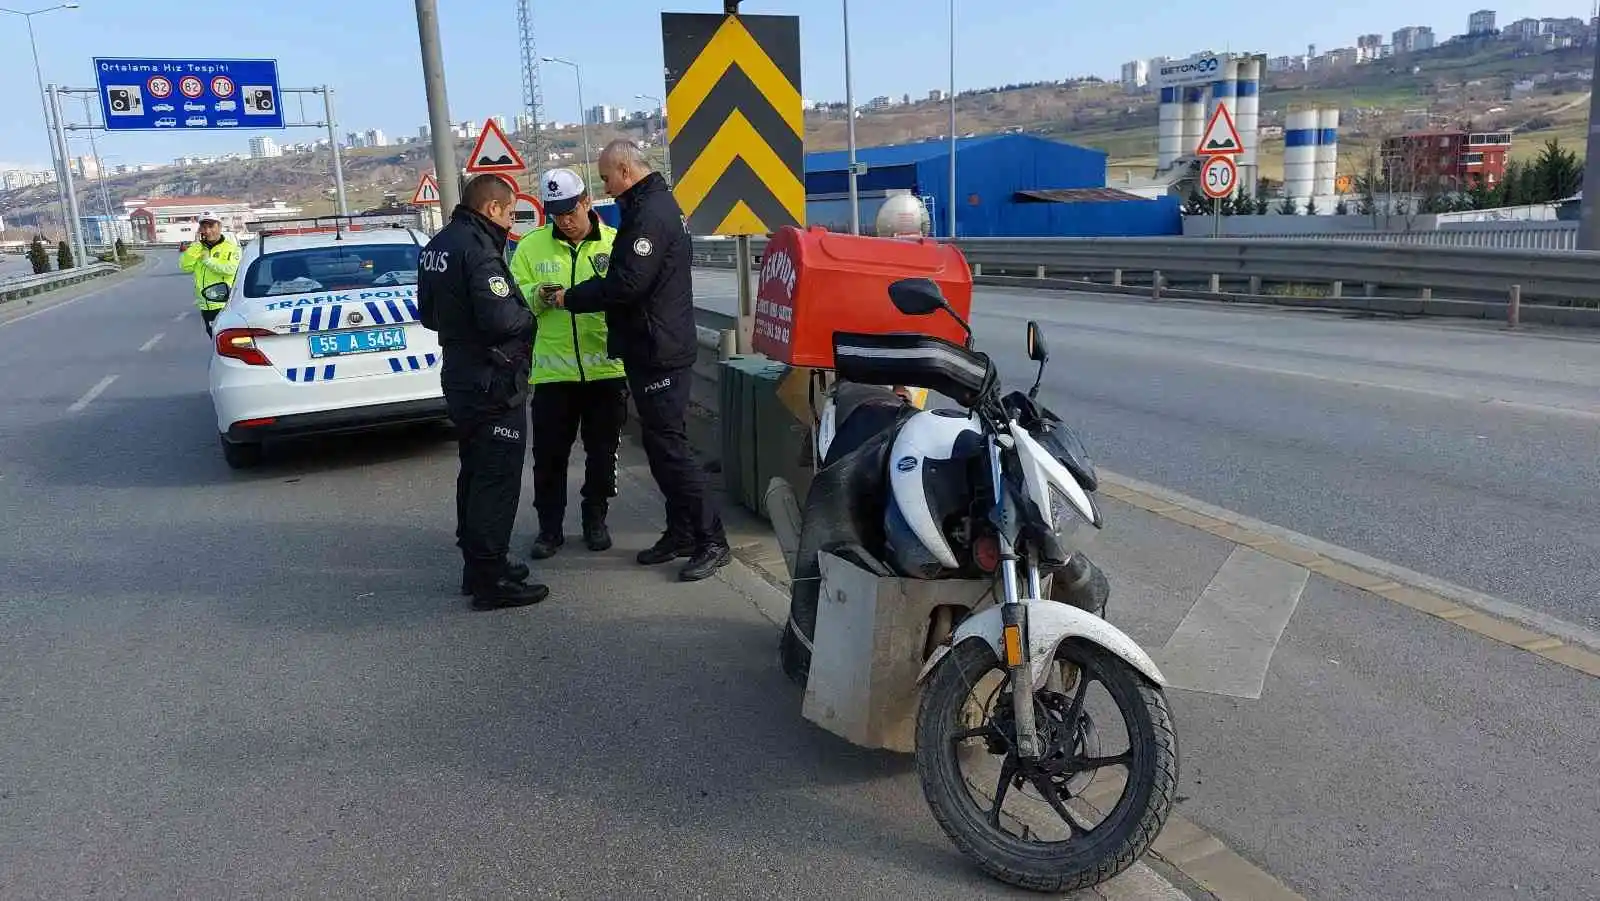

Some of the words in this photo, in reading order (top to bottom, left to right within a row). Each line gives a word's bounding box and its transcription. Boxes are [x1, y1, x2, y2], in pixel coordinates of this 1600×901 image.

[101, 63, 158, 72] Ortalama
[187, 63, 229, 74] Tespiti
[152, 82, 167, 93] 82
[185, 82, 198, 92] 82
[216, 82, 230, 92] 70
[1209, 167, 1229, 186] 50
[360, 289, 416, 300] POLİ
[320, 336, 338, 352] 55
[350, 337, 359, 350] A
[367, 333, 401, 347] 5454
